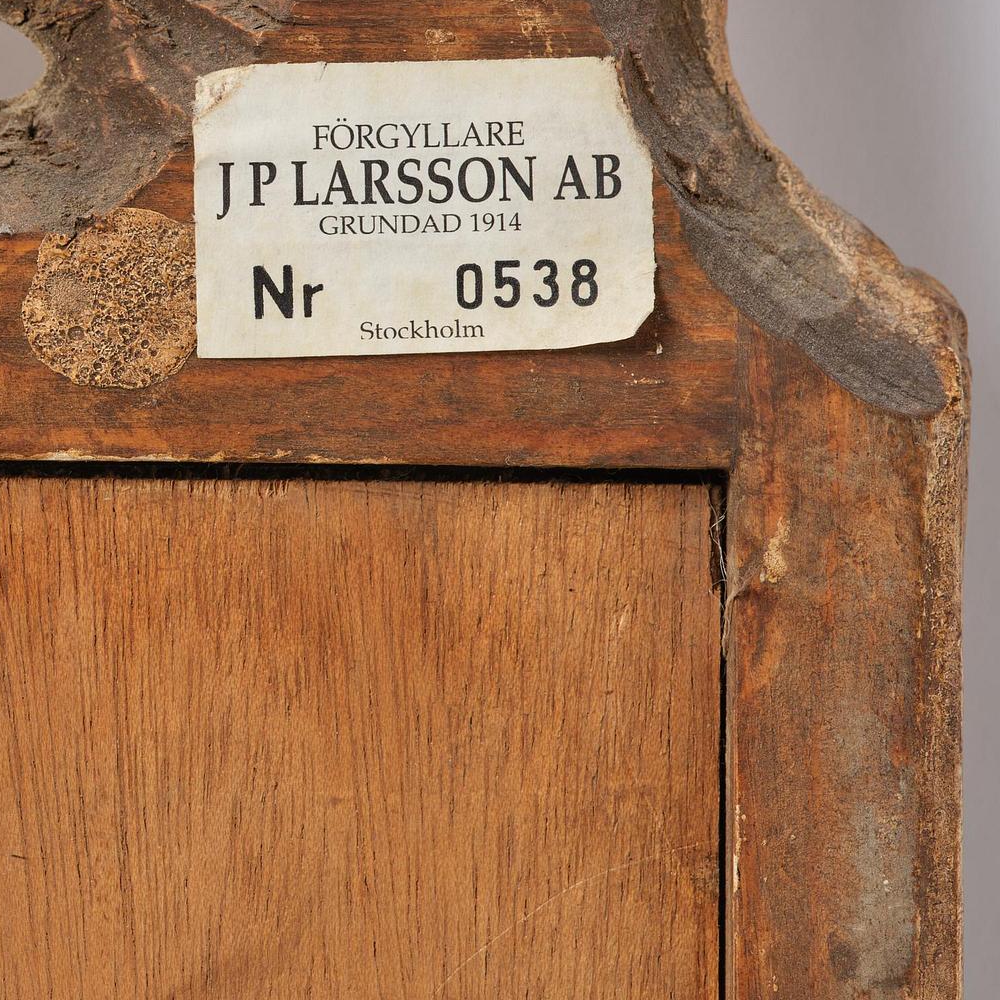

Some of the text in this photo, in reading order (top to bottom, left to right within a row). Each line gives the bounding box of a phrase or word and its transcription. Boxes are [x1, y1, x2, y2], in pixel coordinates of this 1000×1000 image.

[313, 118, 525, 150] FÖRGYLLARE
[217, 153, 622, 220] J P LARSSON AB
[319, 212, 522, 236] GRUNDAD 1914
[253, 258, 599, 319] Nr 0538
[360, 319, 485, 341] Stockholm
